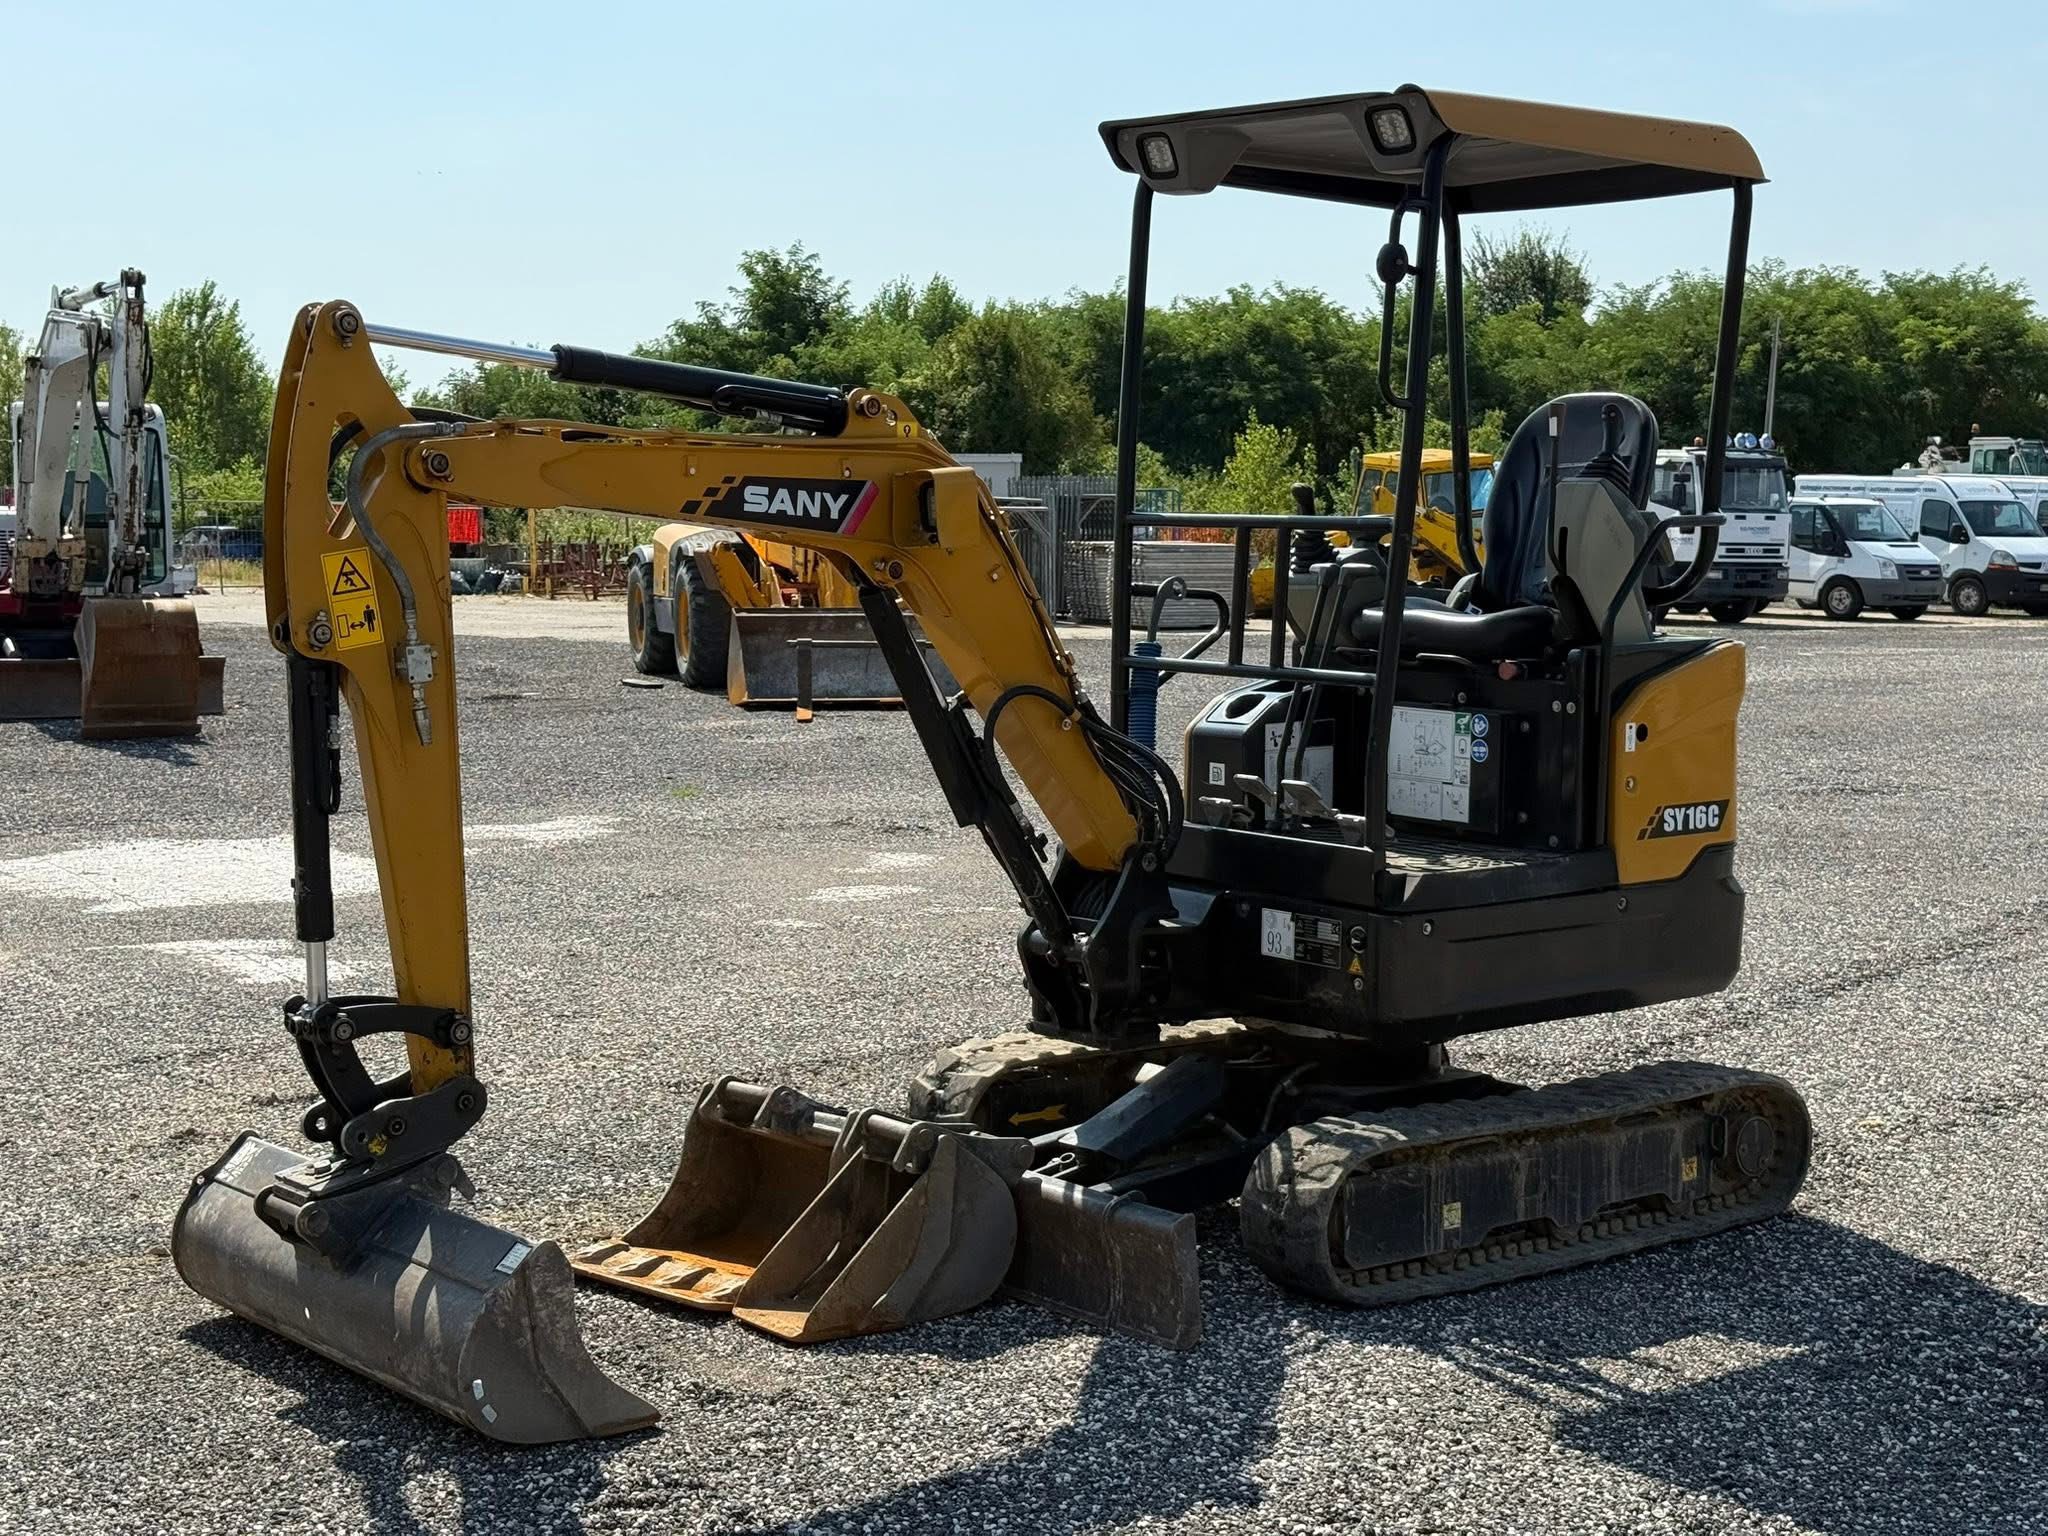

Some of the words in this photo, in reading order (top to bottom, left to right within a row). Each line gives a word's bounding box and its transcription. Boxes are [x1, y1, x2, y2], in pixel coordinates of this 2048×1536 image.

[744, 485, 850, 520] SANY
[1663, 804, 1719, 832] SY16C
[1267, 930, 1282, 955] 93
